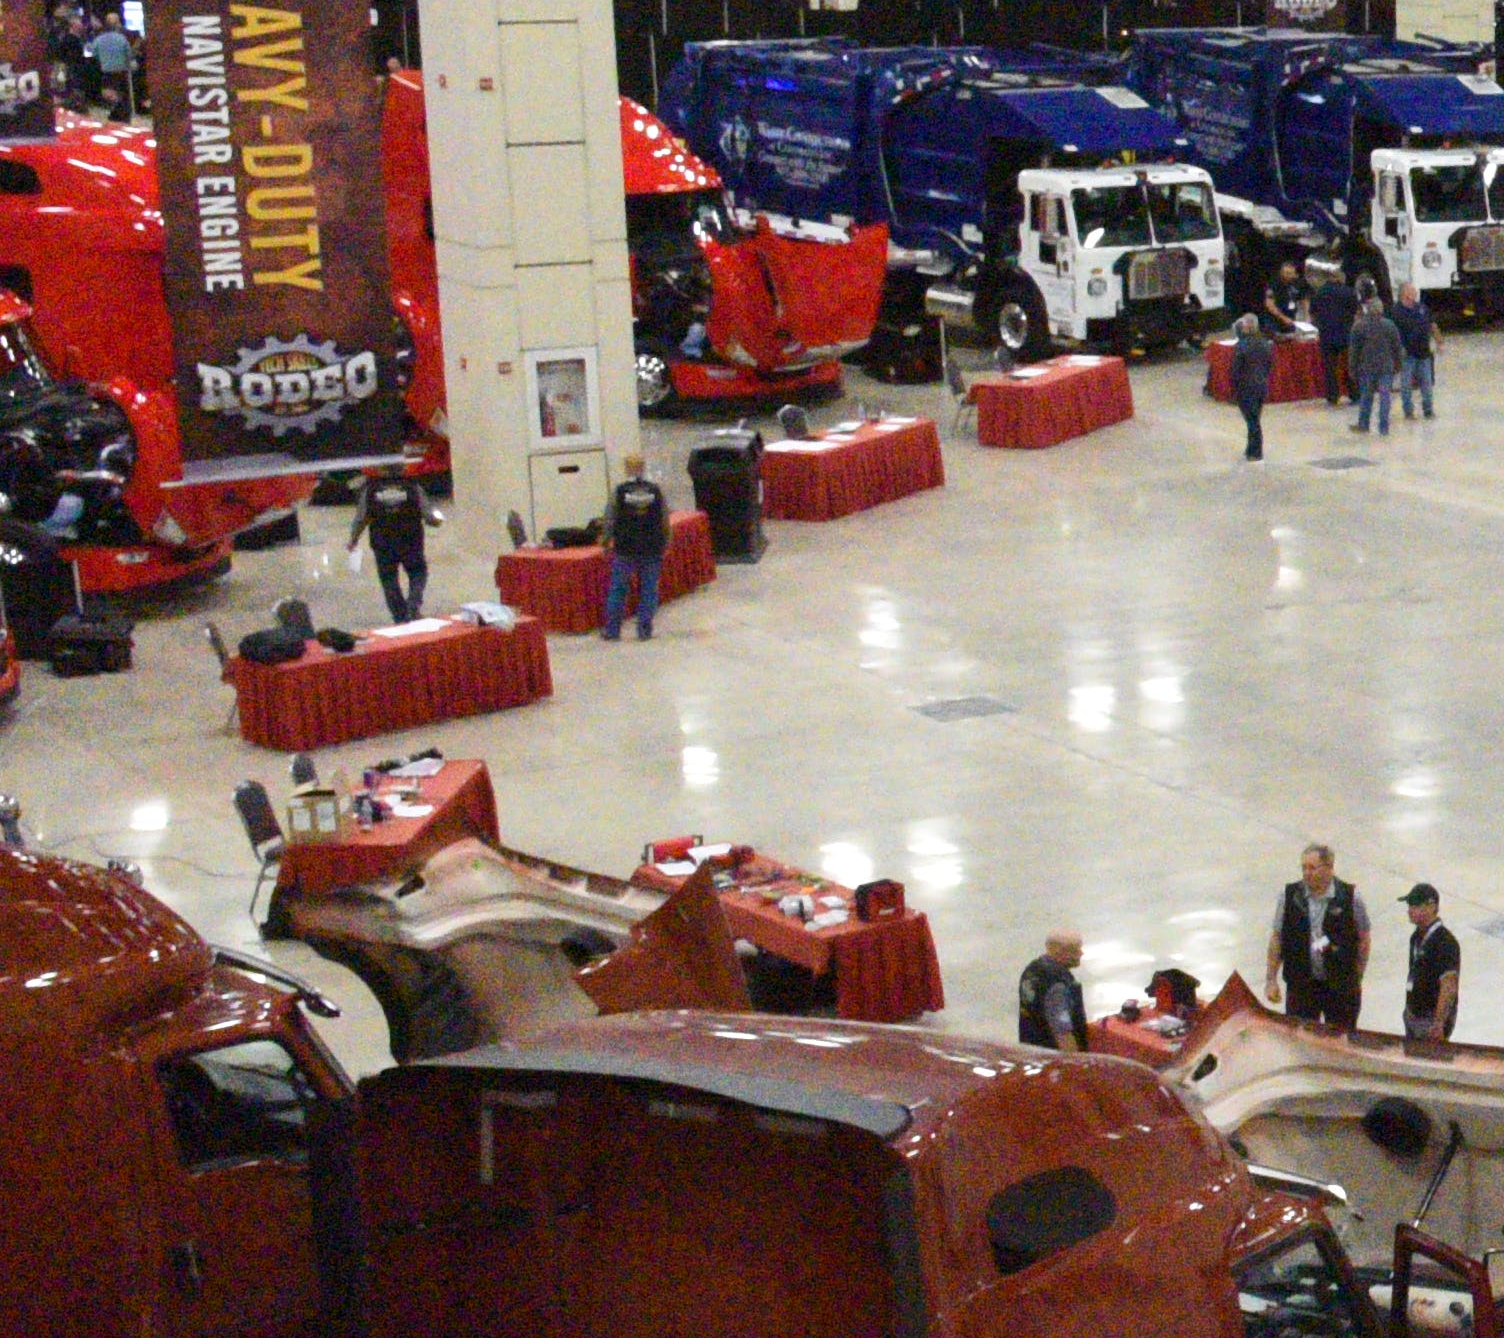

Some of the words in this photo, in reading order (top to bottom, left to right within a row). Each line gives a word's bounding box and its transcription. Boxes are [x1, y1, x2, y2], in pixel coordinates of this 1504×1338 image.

[182, 15, 232, 165] NAVISTAR
[197, 176, 244, 294] ENGINE
[197, 350, 378, 411] RODEO
